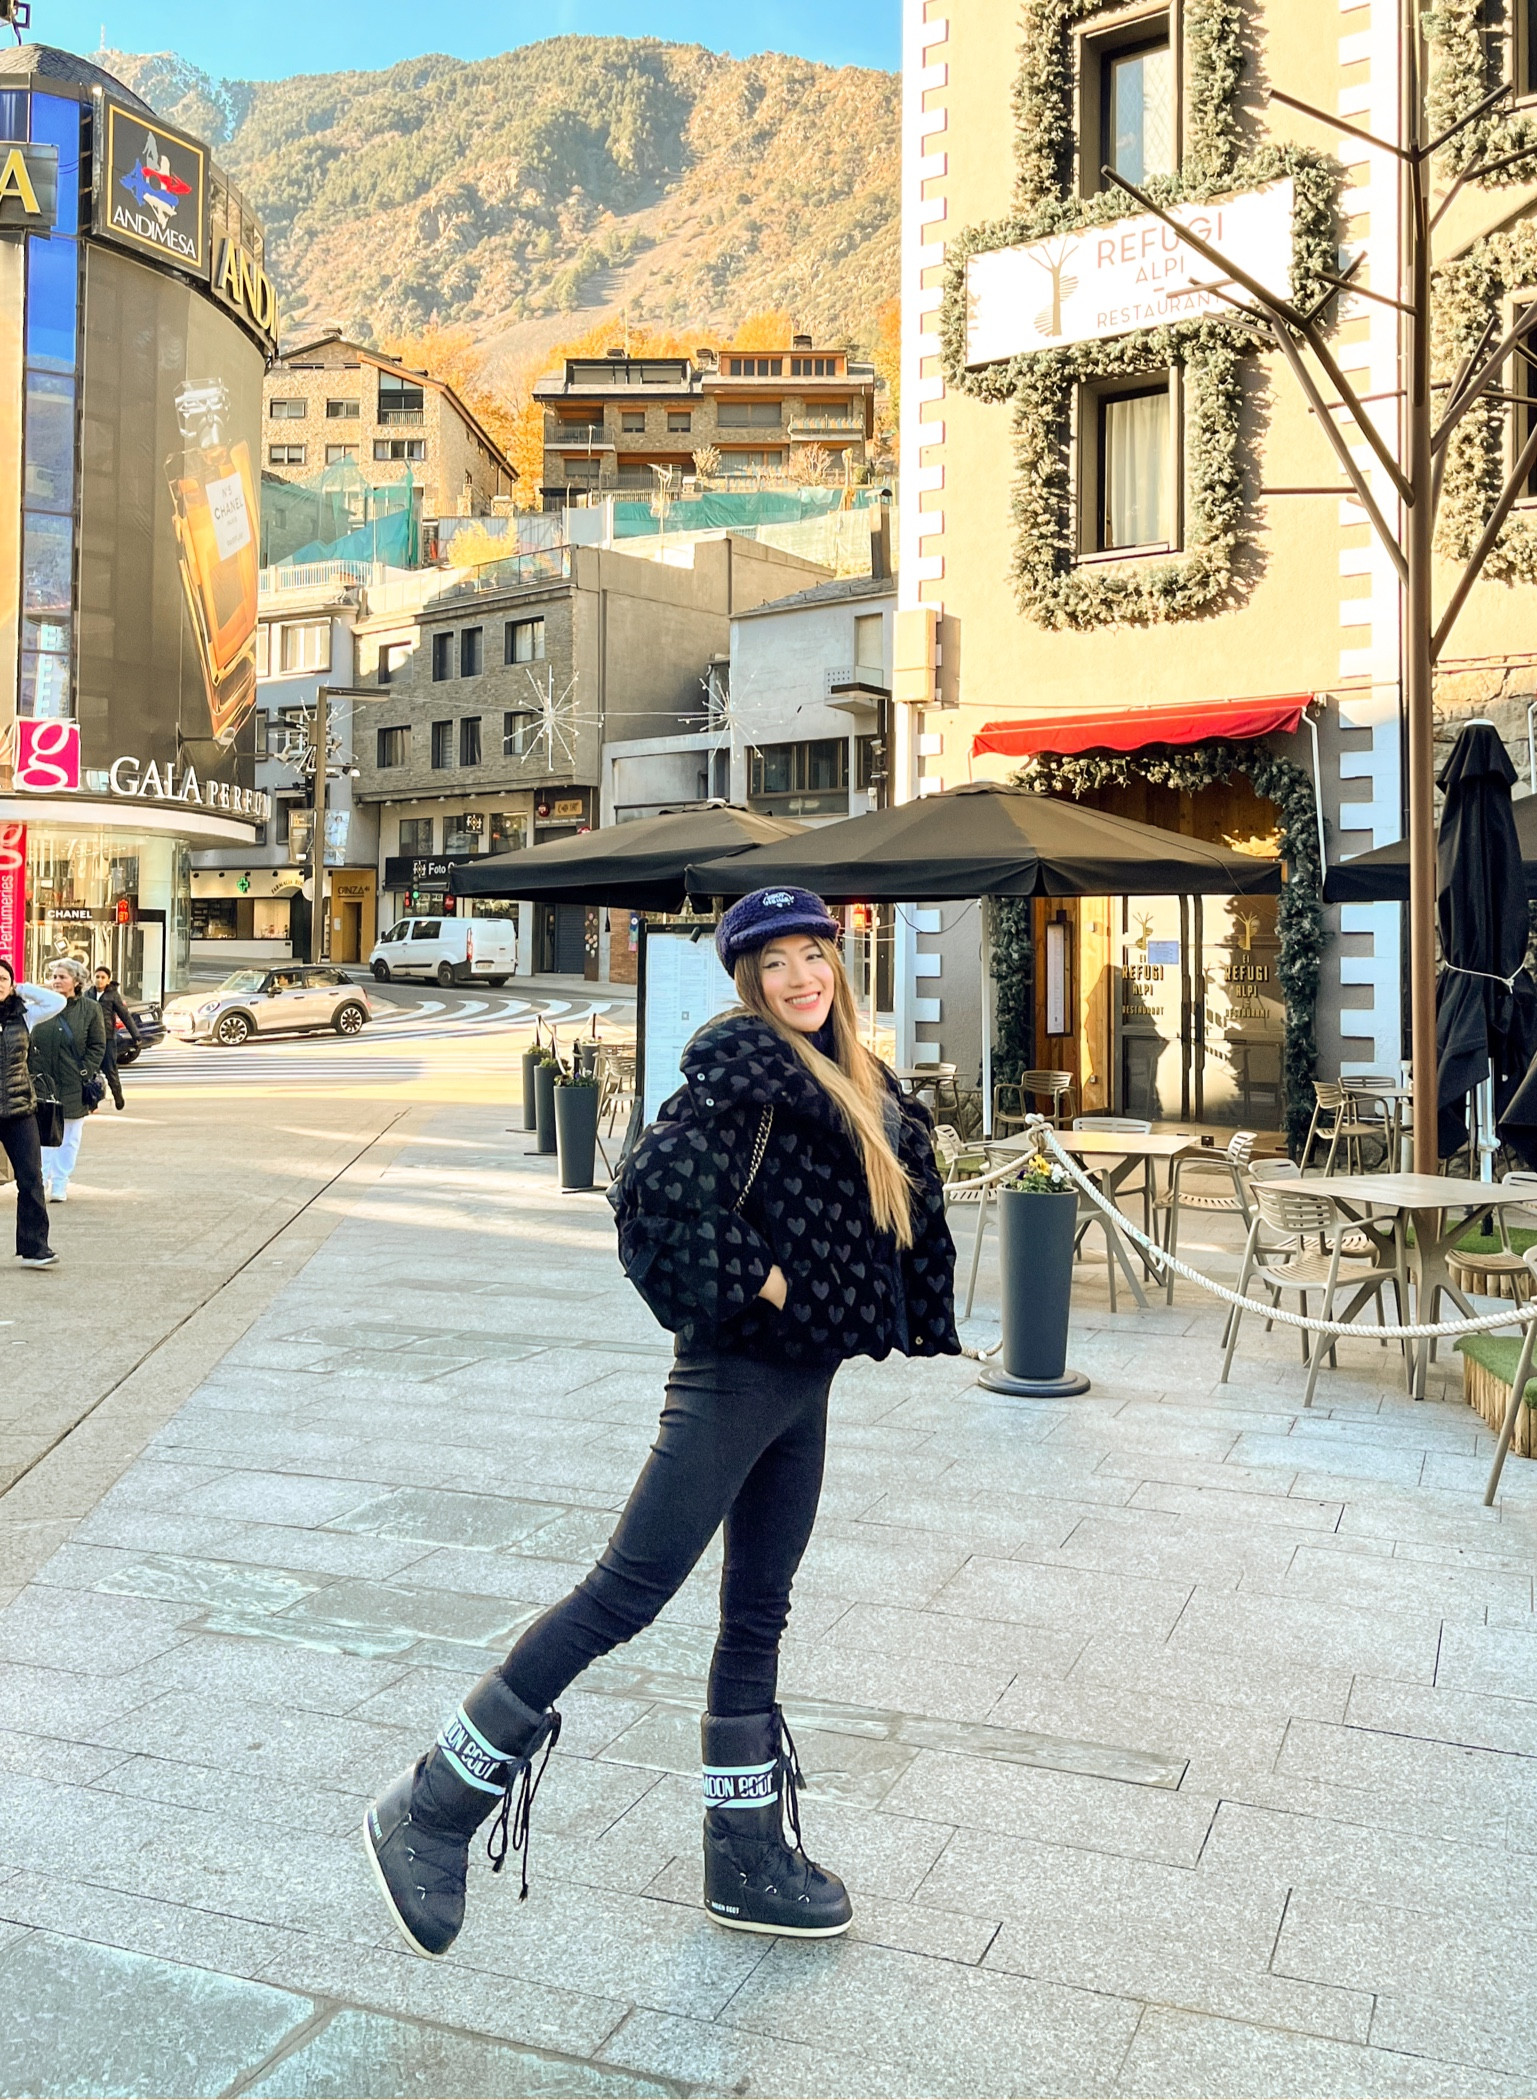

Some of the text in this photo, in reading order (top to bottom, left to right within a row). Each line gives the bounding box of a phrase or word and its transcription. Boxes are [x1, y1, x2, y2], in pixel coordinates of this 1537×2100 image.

[113, 205, 197, 259] ANDIMESA
[1097, 211, 1223, 269] REFUGI
[214, 497, 244, 520] CHANEL
[109, 756, 203, 804] GALA
[428, 862, 447, 875] Foto
[47, 909, 93, 919] CHANEL
[1122, 964, 1164, 981] REFUGI
[1225, 965, 1270, 983] REFUGI
[1122, 1004, 1165, 1017] RESTAURANT
[1225, 1006, 1270, 1019] RESTAURANT
[703, 1774, 735, 1798] MOON
